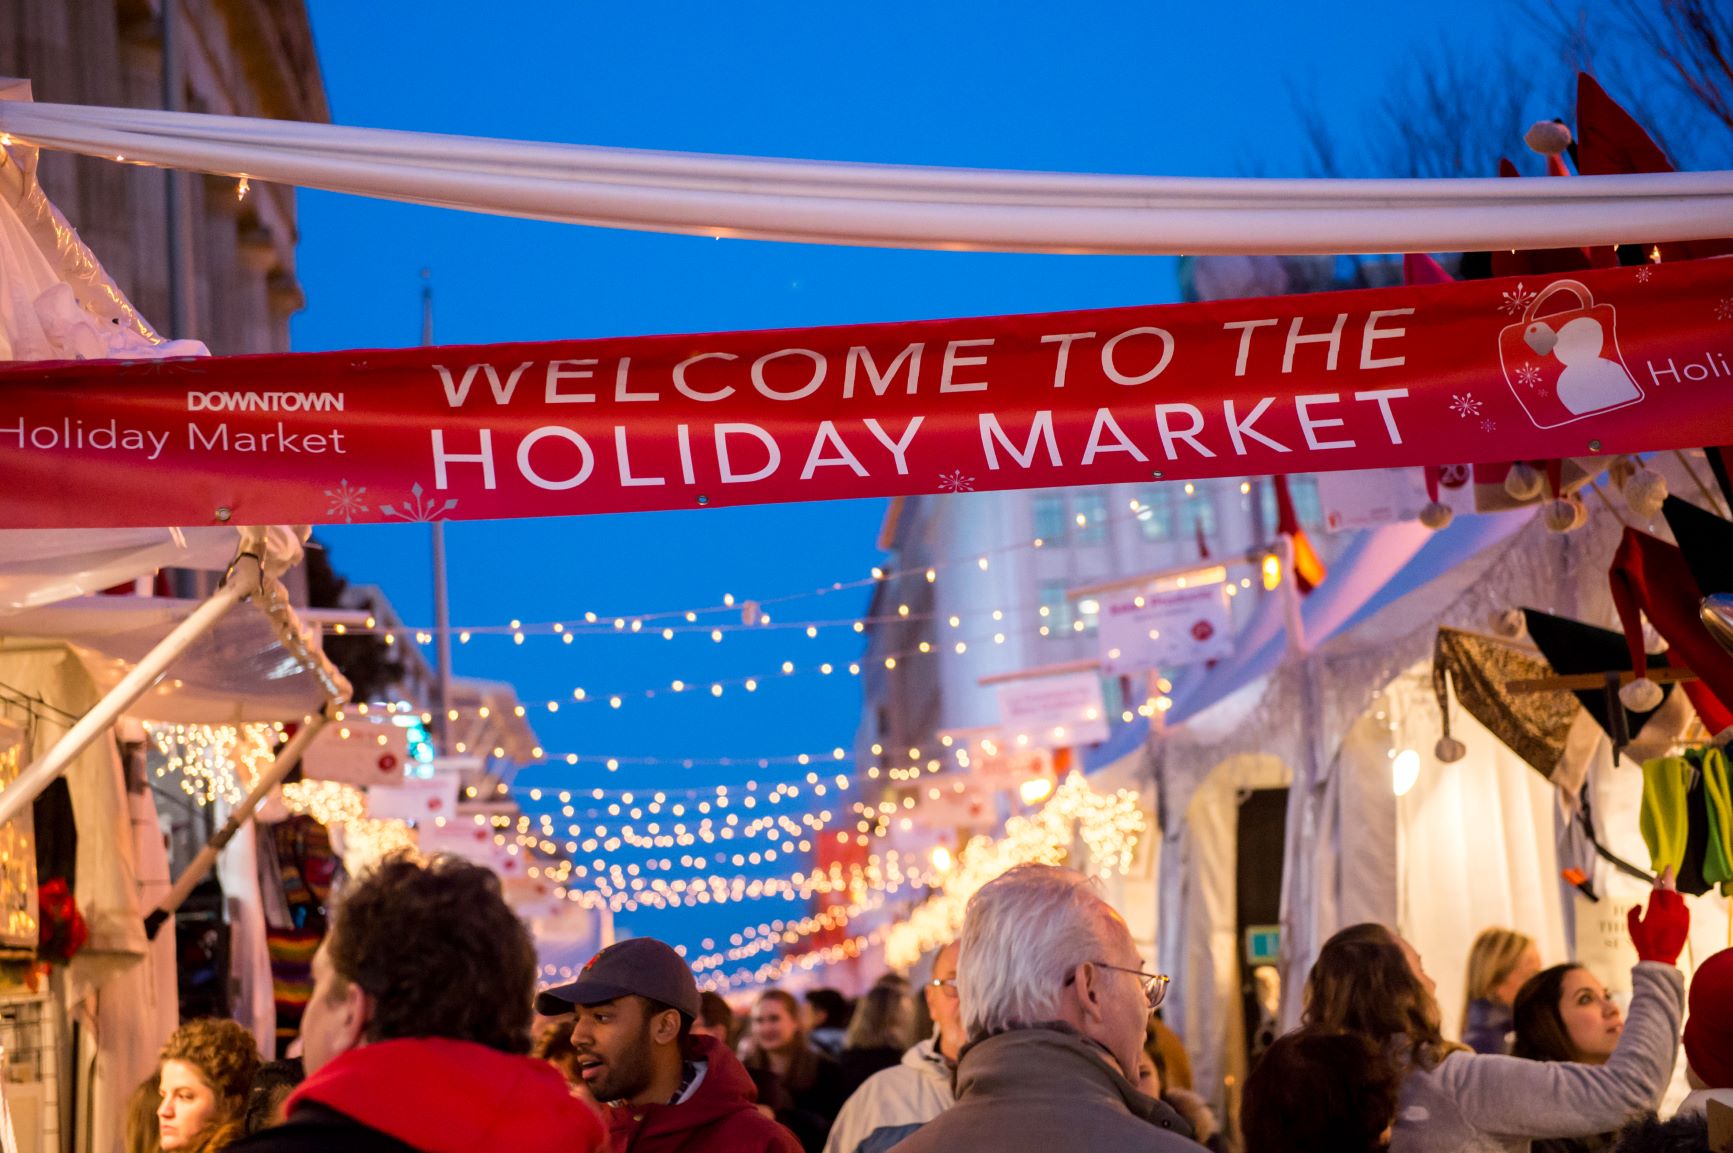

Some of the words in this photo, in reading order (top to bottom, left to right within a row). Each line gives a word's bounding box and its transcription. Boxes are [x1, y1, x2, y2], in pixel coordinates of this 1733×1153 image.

[432, 338, 995, 408] WELCOME
[1040, 326, 1175, 388] TO
[1223, 307, 1415, 377] THE
[187, 391, 344, 411] DOWNTOWN
[188, 421, 346, 454] Market
[431, 415, 925, 490] HOLIDAY
[978, 388, 1409, 470] MARKET
